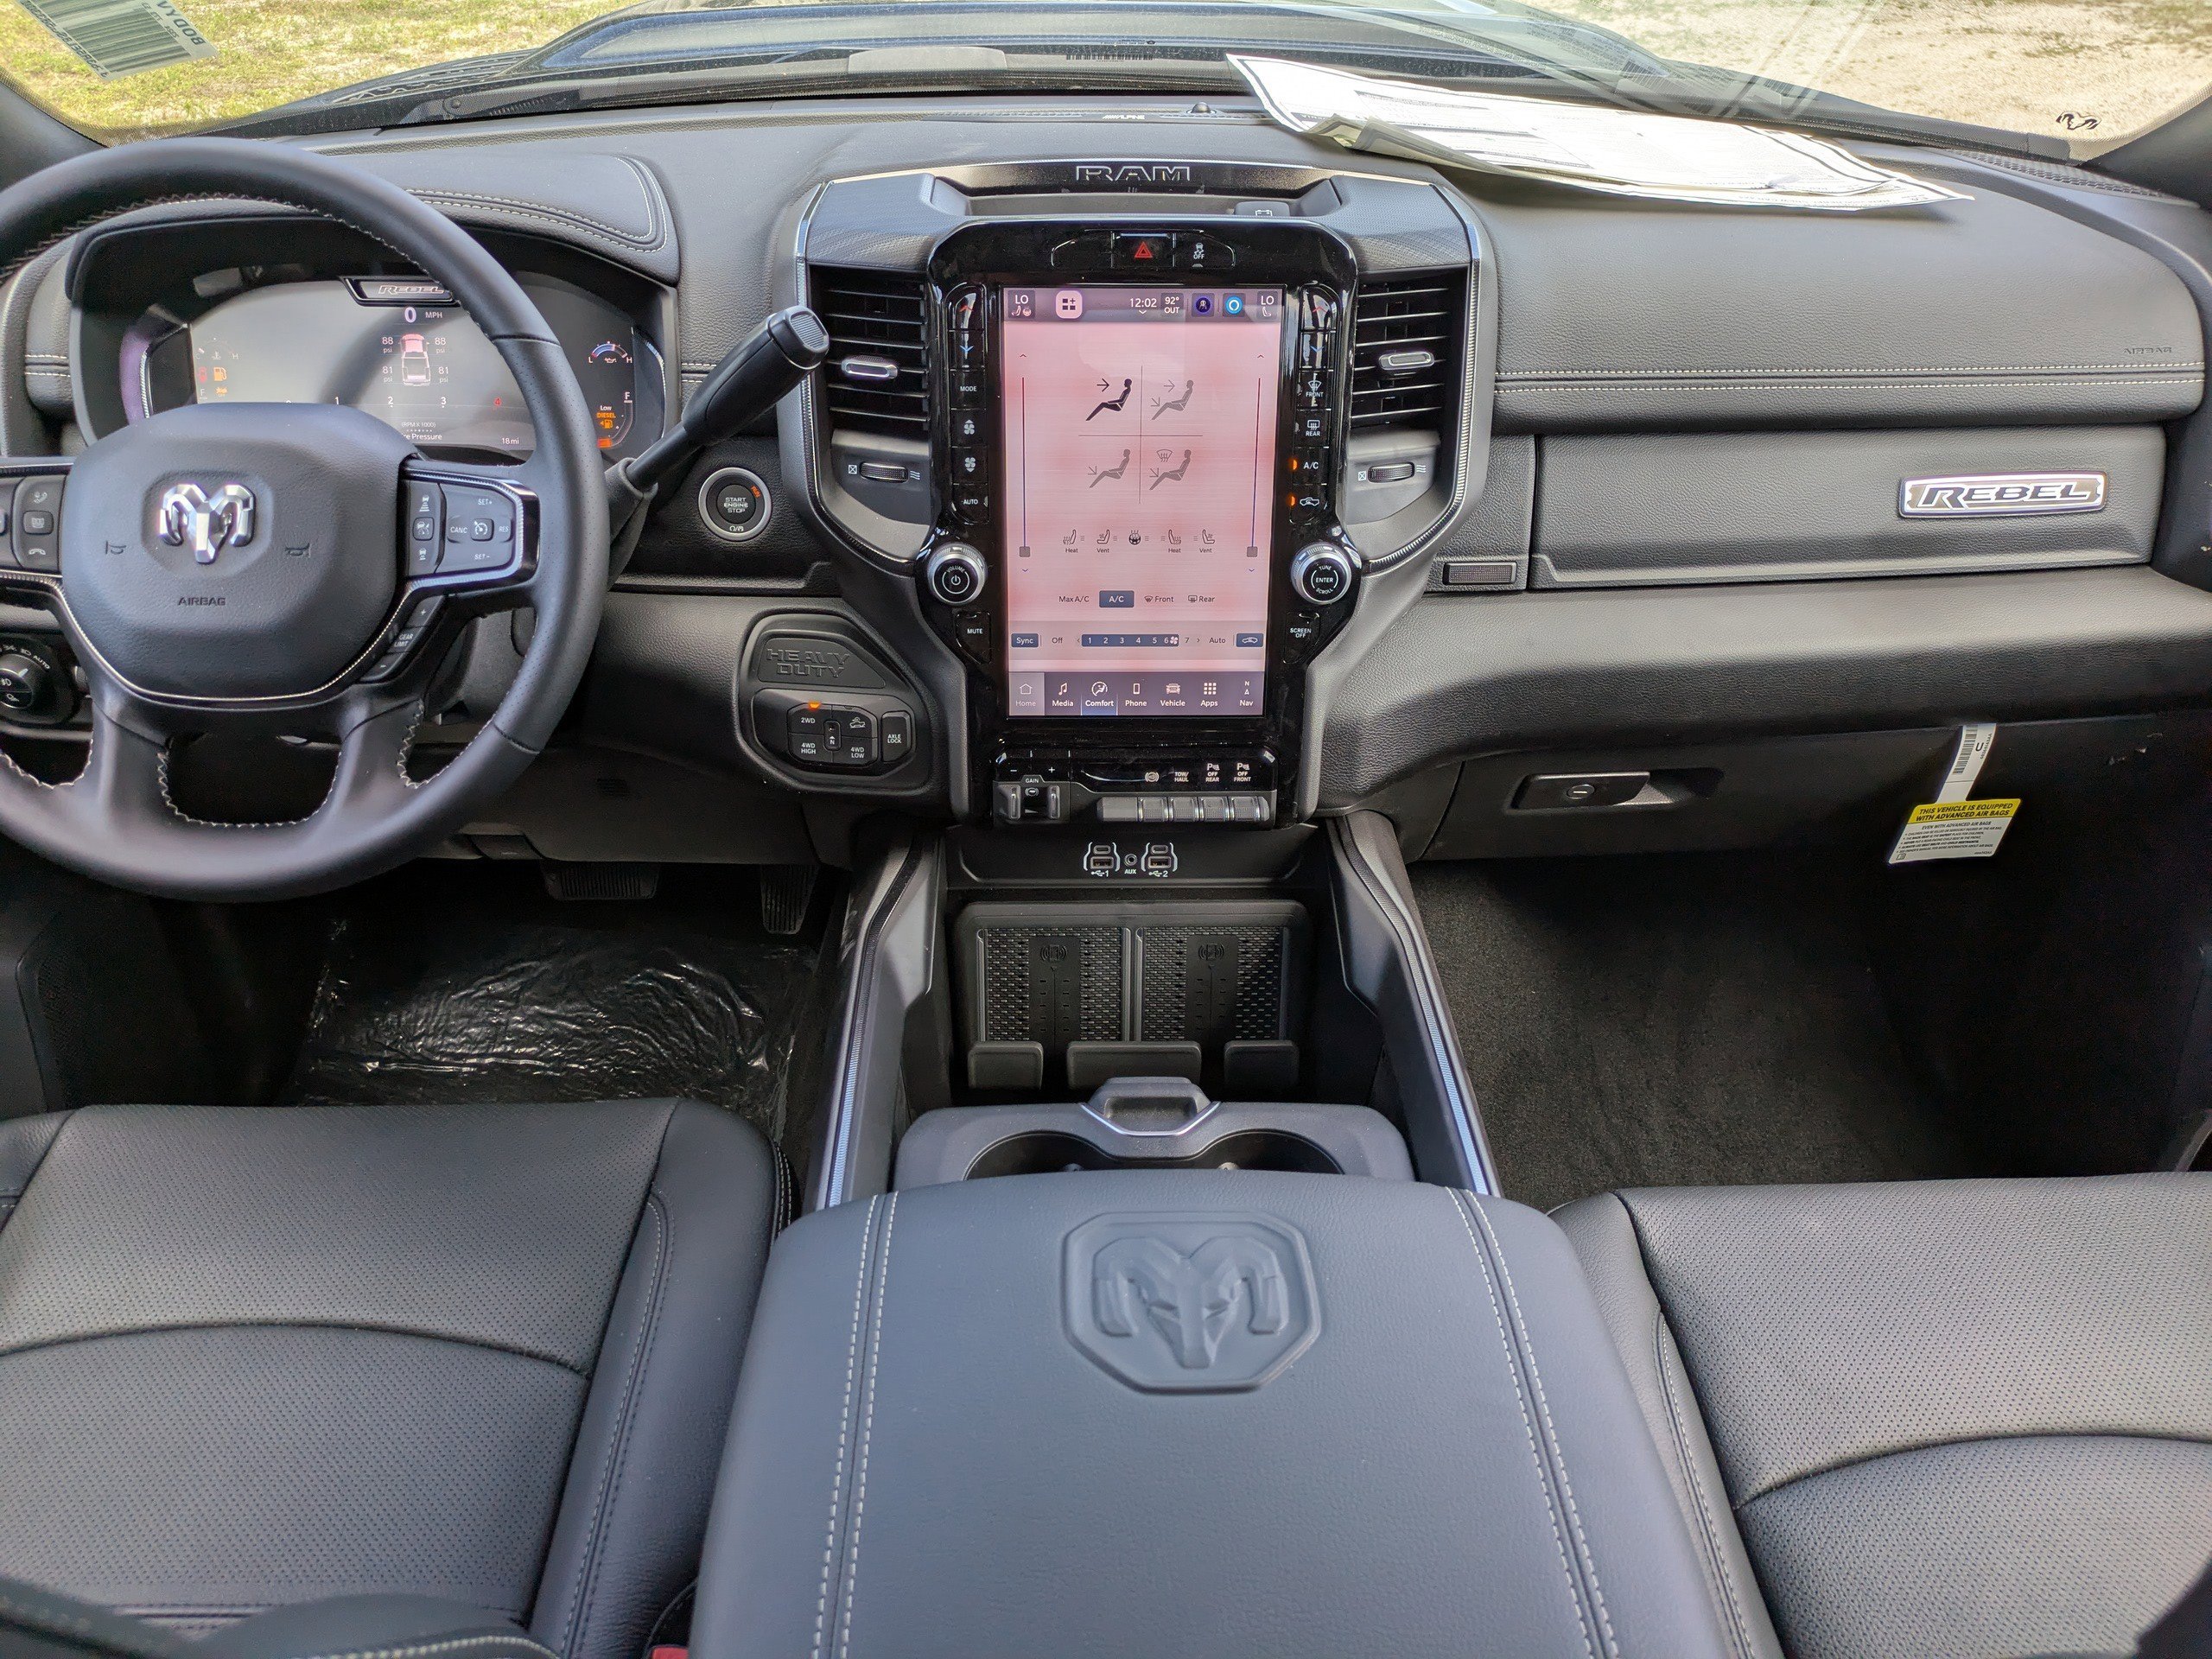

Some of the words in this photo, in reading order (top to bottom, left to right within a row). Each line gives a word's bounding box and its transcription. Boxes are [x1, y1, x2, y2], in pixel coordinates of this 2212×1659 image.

[1076, 165, 1191, 181] RAM
[378, 284, 445, 296] REBEL
[1014, 295, 1029, 305] LO
[1129, 298, 1158, 308] 12:02
[1261, 296, 1274, 305] LO
[404, 307, 417, 323] 0
[382, 336, 394, 345] 88
[435, 337, 447, 346] 88
[2123, 346, 2173, 356] AIRBAG
[382, 365, 393, 374] 81
[438, 366, 449, 375] 81
[625, 391, 631, 400] F
[387, 396, 394, 404] 2
[441, 397, 447, 405] 3
[411, 433, 442, 442] Pressure
[1917, 481, 2091, 510] REBEL
[178, 596, 226, 607] AIRBAG
[1016, 637, 1034, 645] Sync
[766, 647, 850, 665] HEAVY
[33, 655, 50, 669] AUTO
[777, 663, 846, 677] DUTY
[1085, 699, 1115, 708] Comfort
[1125, 699, 1147, 708] Phone
[1160, 699, 1185, 708] Vehicle
[1200, 700, 1218, 709] Apps
[1936, 811, 1974, 820] ADVANCED
